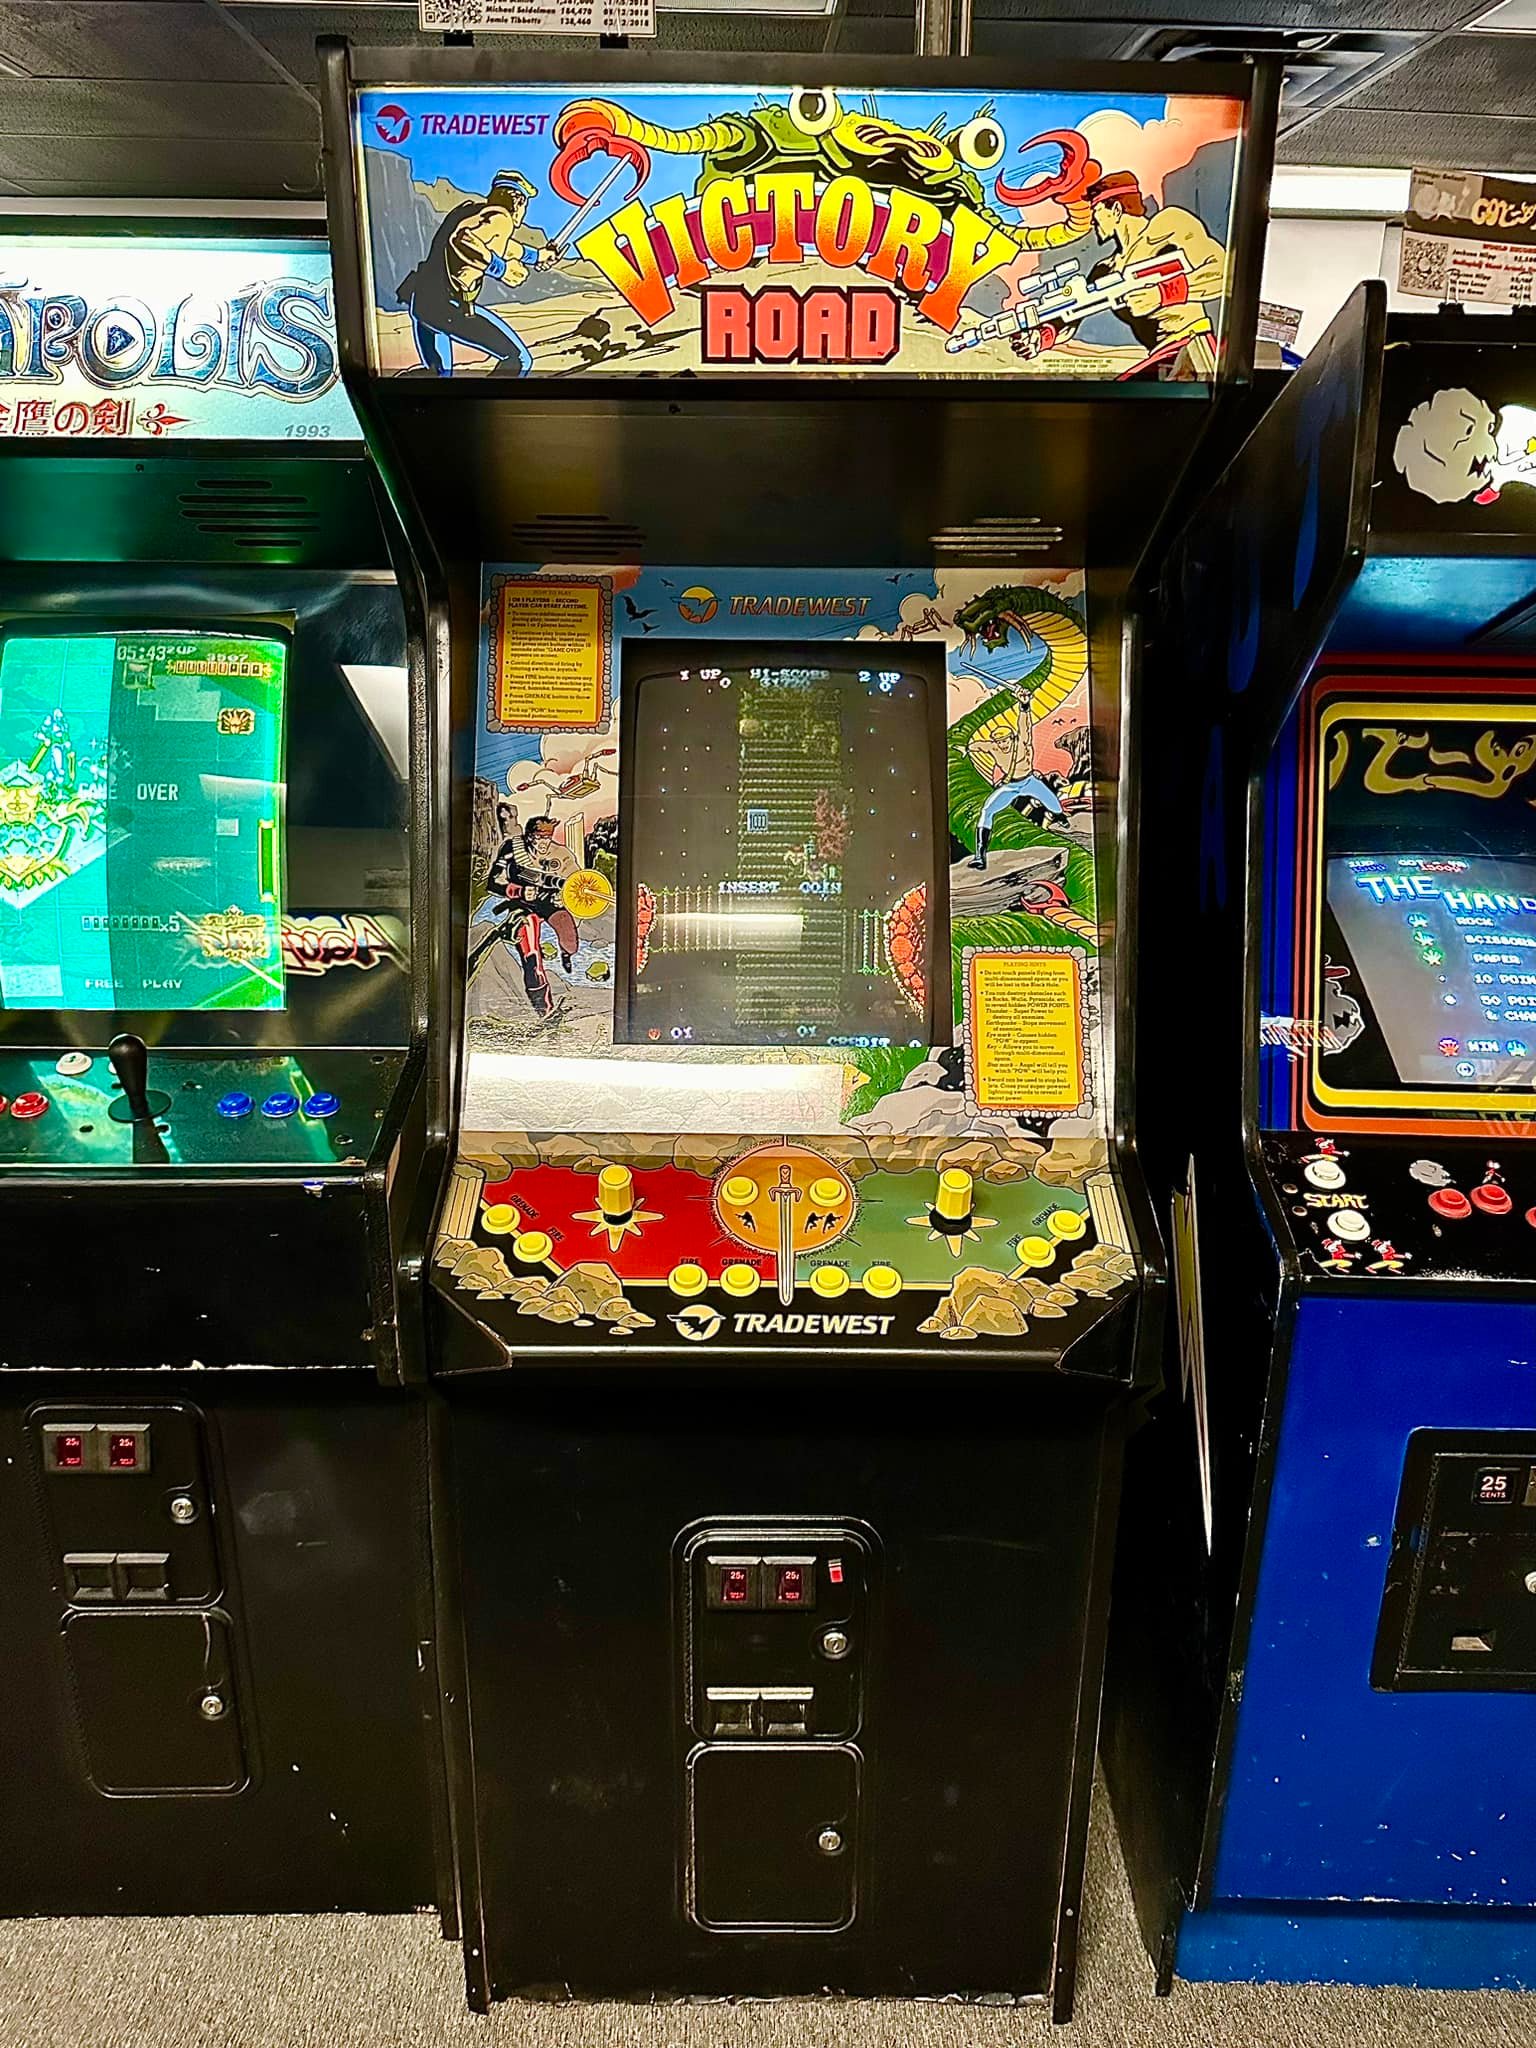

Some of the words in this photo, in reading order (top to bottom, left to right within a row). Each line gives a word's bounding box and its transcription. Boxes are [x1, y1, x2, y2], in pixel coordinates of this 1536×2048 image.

[420, 113, 551, 136] TRADEWEST
[575, 171, 1021, 334] VICTORY
[702, 286, 899, 364] ROAD
[285, 424, 330, 438] 1993
[730, 595, 872, 616] TRADEWEST
[117, 646, 166, 660] 05:43
[700, 669, 721, 680] UP
[750, 668, 831, 679] HI-SCORE
[858, 670, 871, 681] 2
[879, 672, 901, 683] UP
[720, 677, 731, 688] 0
[879, 682, 890, 692] 0
[137, 783, 178, 801] OVER
[718, 881, 780, 894] INSERT
[800, 880, 842, 894] COIN
[1355, 875, 1441, 904] THE
[1441, 886, 1536, 914] HAND
[1455, 917, 1495, 927] ROCK
[1472, 952, 1521, 965] PAPER
[85, 978, 124, 989] FREE
[143, 979, 183, 989] PLAY
[1474, 972, 1494, 984] 10
[1467, 1039, 1500, 1053] WIN
[510, 1194, 540, 1219] GRENADE
[1303, 1192, 1369, 1209] START
[547, 1226, 566, 1242] FIRE
[1006, 1233, 1023, 1248] FIRE
[810, 1259, 850, 1268] GRENADE
[734, 1313, 896, 1335] TRADEWEST
[1480, 1475, 1507, 1491] 25
